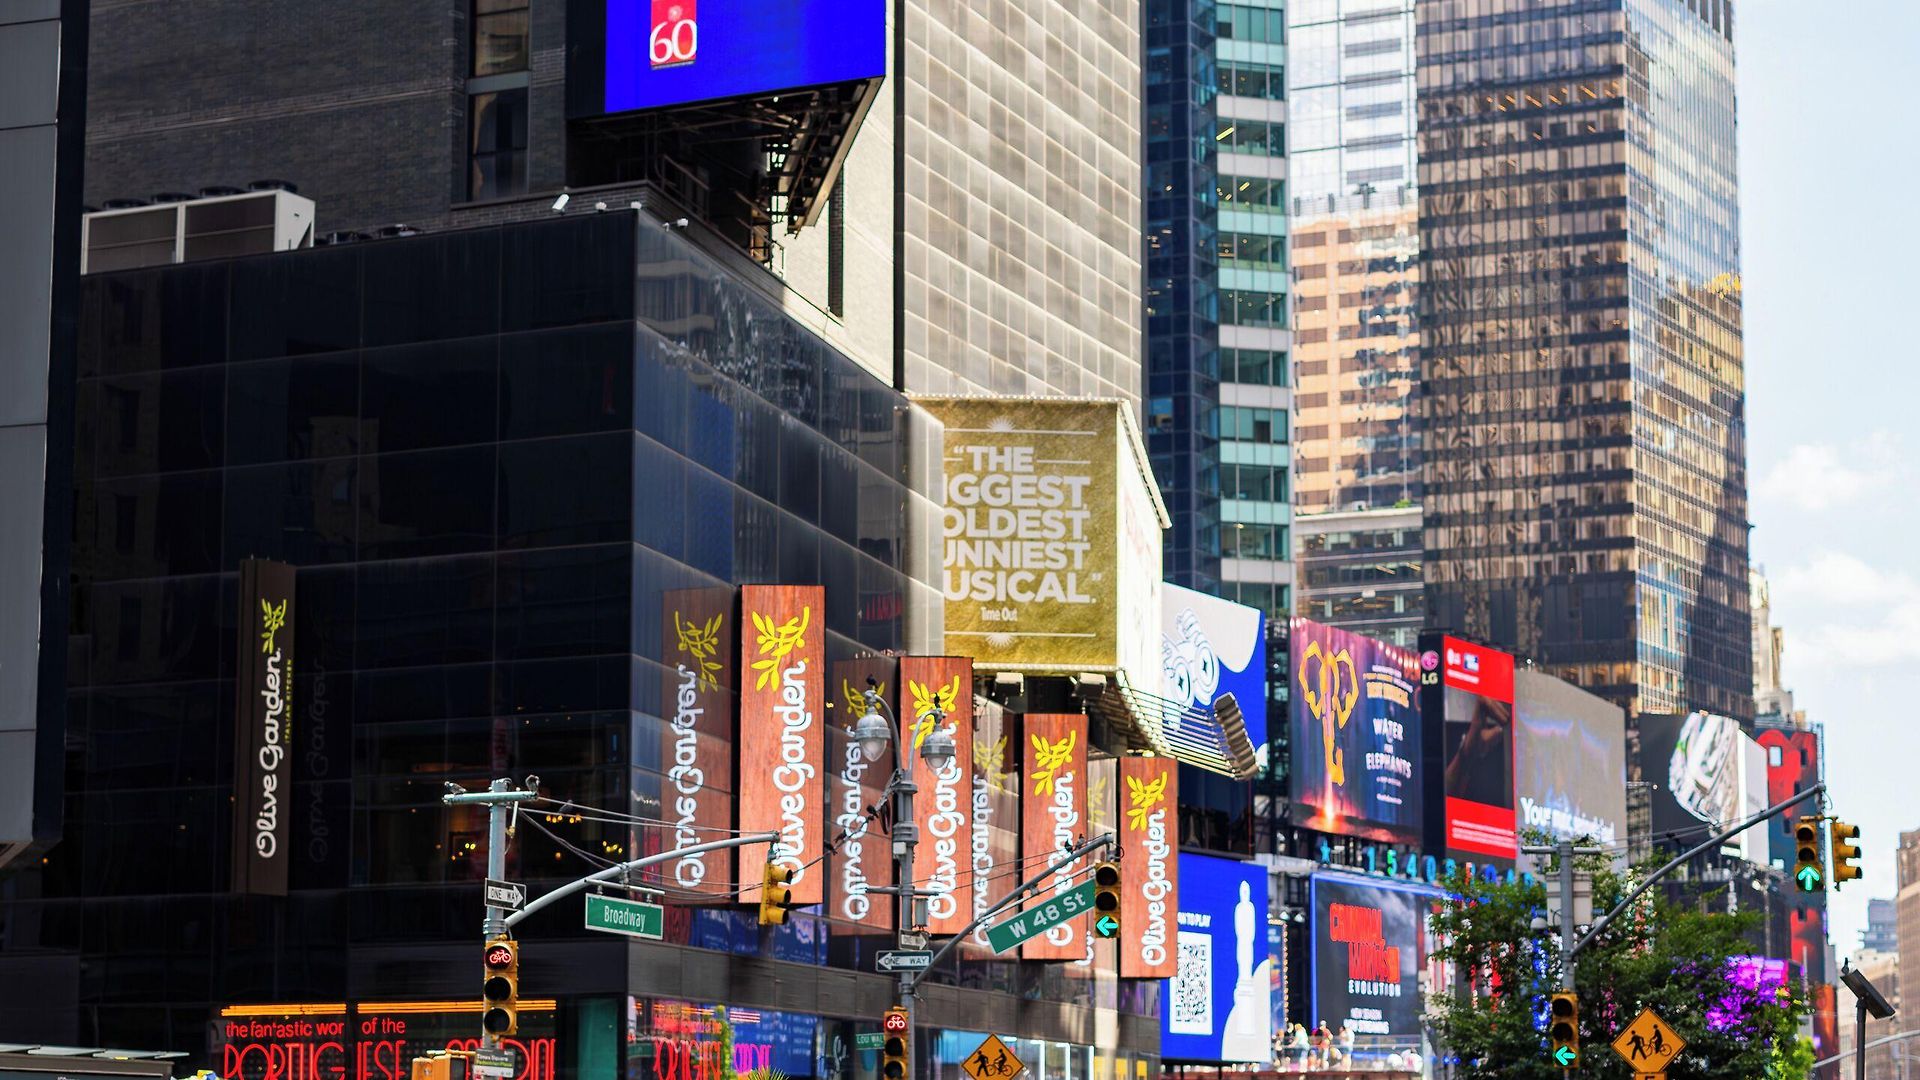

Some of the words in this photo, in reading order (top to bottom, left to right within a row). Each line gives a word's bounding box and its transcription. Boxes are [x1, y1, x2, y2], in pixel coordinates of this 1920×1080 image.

[650, 19, 698, 63] 60
[953, 445, 1034, 472] “THE
[981, 607, 1001, 621] Time
[1001, 607, 1018, 621] Out
[1421, 672, 1438, 685] LG
[259, 650, 284, 770] Garden
[772, 660, 814, 792] Garden
[1372, 717, 1404, 742] WATER
[1365, 752, 1412, 779] ELEPHANTS
[928, 722, 965, 838] Gar
[256, 774, 277, 858] Olive
[1141, 808, 1172, 899] Garden
[927, 839, 957, 919] Olive
[490, 888, 503, 899] ONE
[508, 890, 521, 901] WAY
[603, 905, 646, 933] Broadway
[1008, 919, 1027, 939] W
[1033, 904, 1060, 927] 48
[1062, 892, 1086, 912] St
[1141, 900, 1167, 966] Olive
[885, 957, 900, 965] ONE
[910, 957, 926, 965] WAY
[1348, 980, 1401, 997] EVOLUTION
[226, 1021, 248, 1038] the
[250, 1020, 312, 1038] fanastic
[361, 1016, 378, 1034] of
[382, 1017, 406, 1034] the
